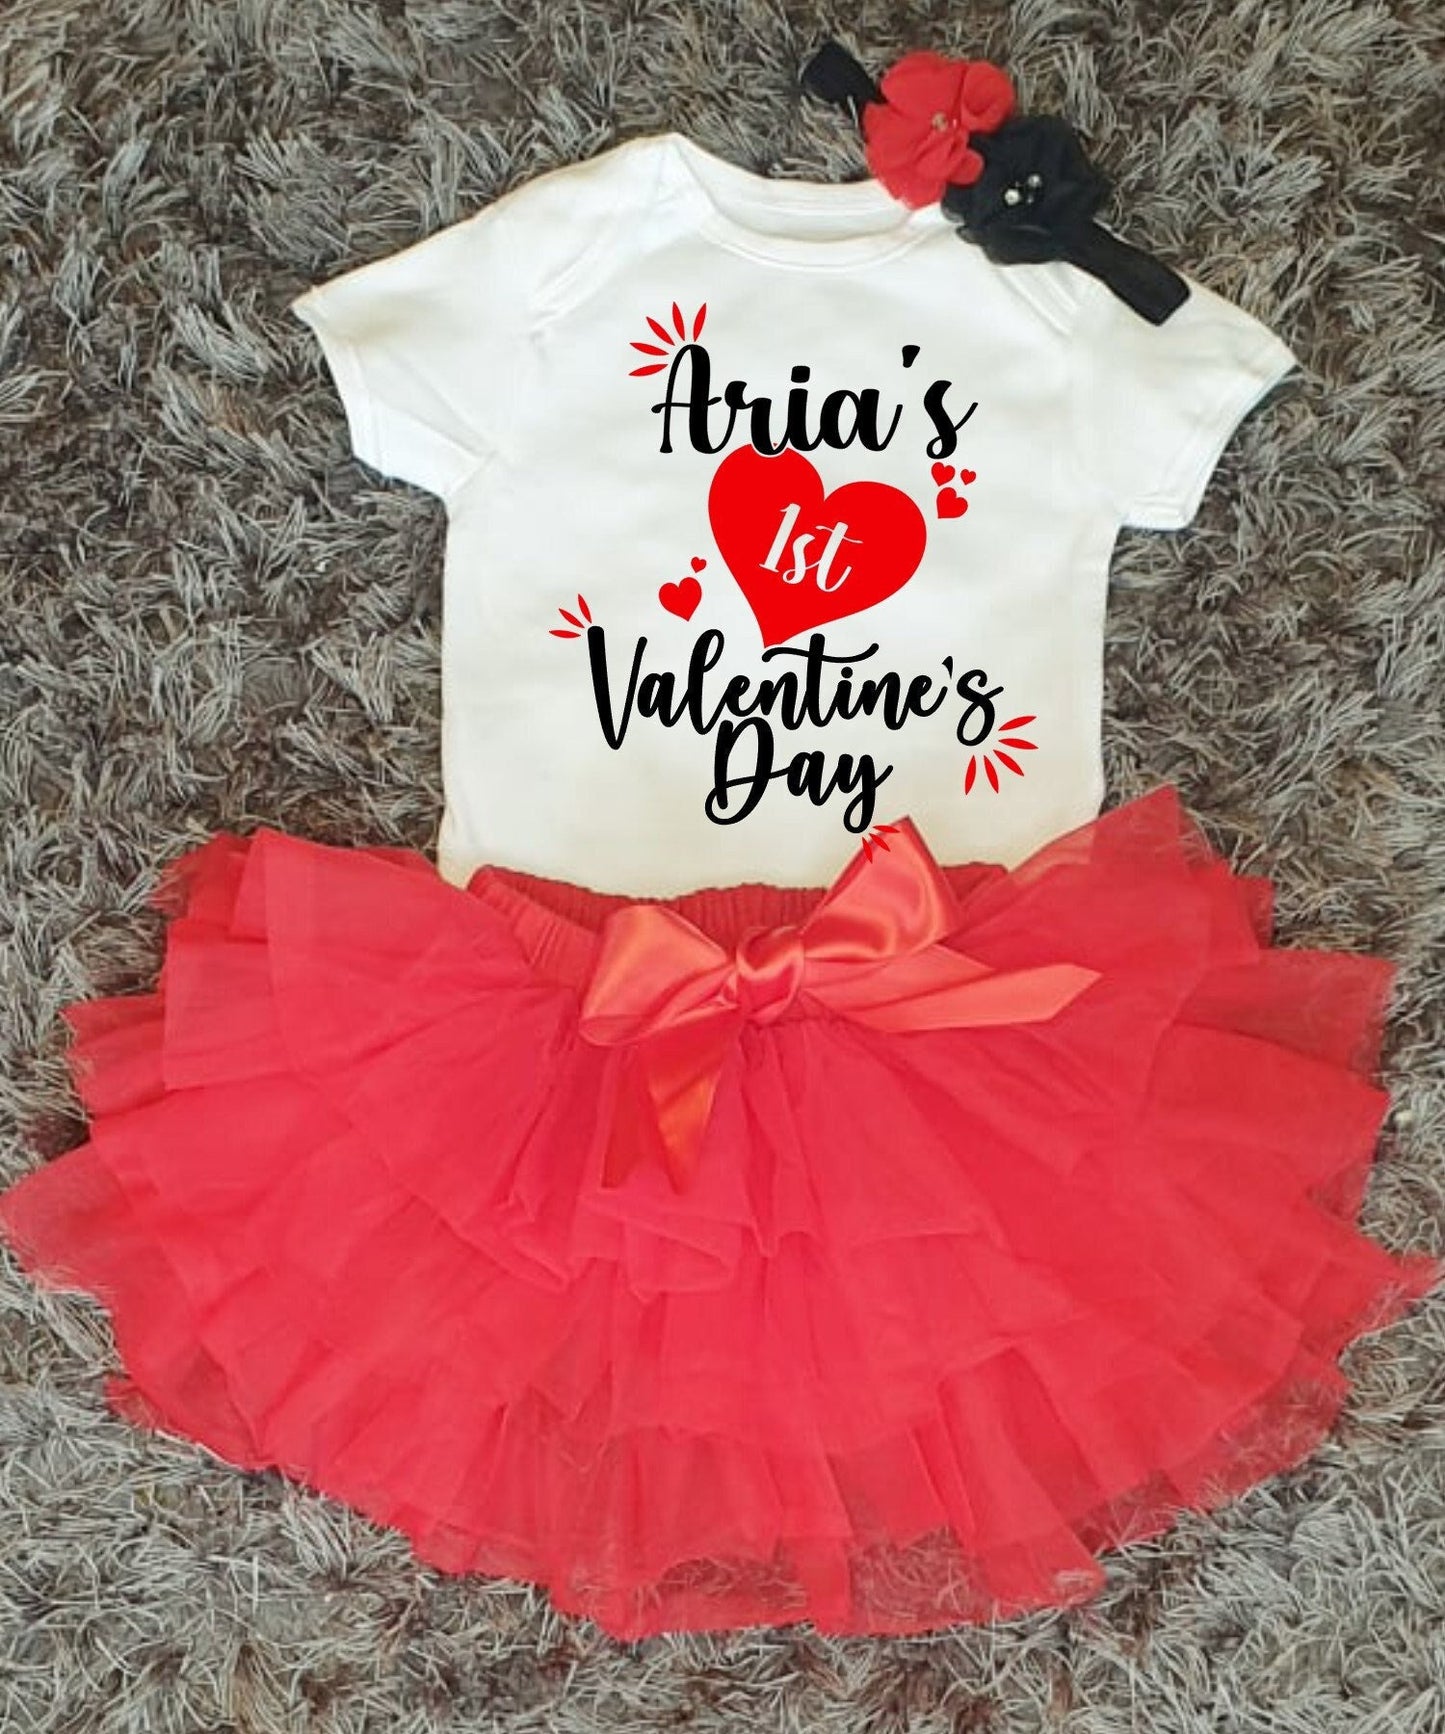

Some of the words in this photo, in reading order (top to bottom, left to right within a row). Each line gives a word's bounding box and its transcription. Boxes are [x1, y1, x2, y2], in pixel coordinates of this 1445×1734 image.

[651, 344, 979, 460] Aria's
[760, 503, 863, 593] 1st
[587, 625, 1005, 751] Valentine's
[704, 716, 894, 834] Day
